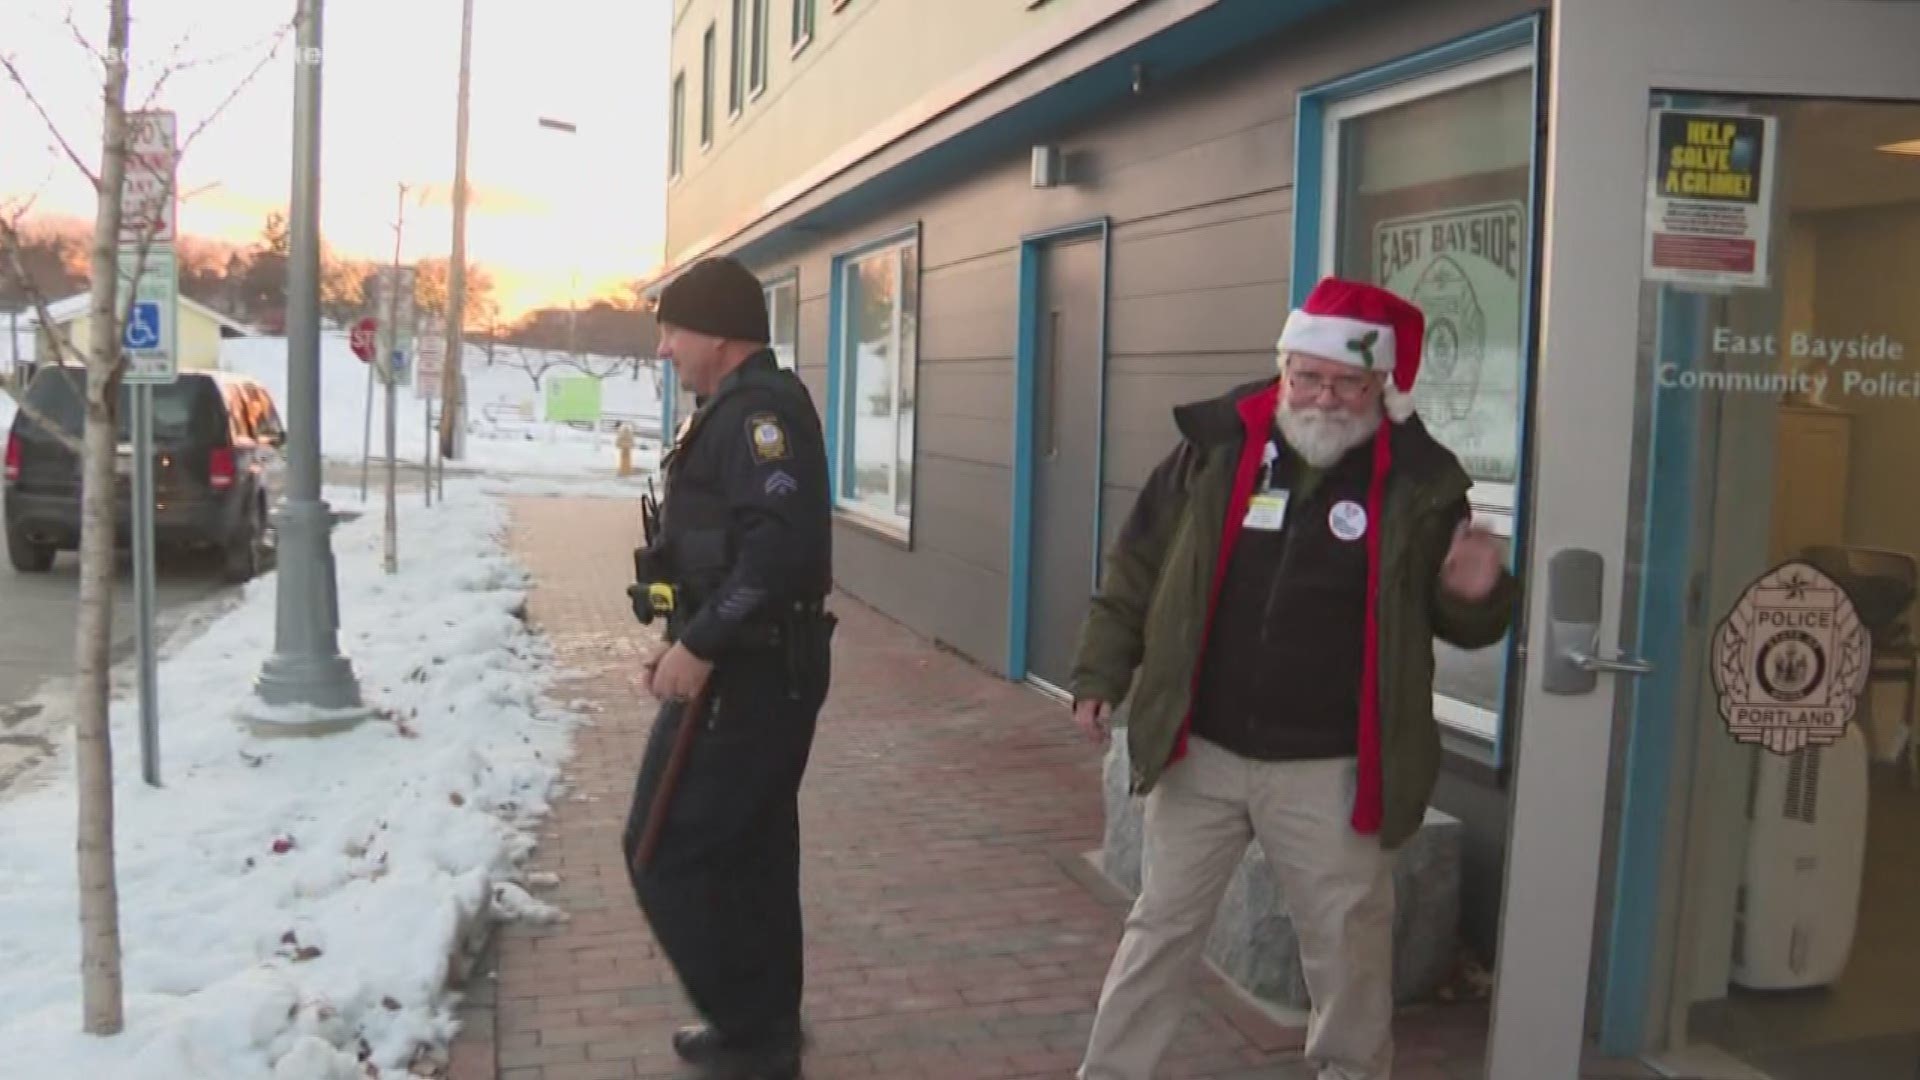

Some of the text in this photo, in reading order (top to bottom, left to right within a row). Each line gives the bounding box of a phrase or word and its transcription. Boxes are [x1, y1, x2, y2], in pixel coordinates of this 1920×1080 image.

[1687, 120, 1737, 146] HELP
[1669, 145, 1731, 171] SOLVE
[1665, 169, 1752, 198] A CRIME!
[1379, 215, 1518, 288] EAST BAYSIDE
[1712, 327, 1905, 365] East Bayside
[1658, 361, 1828, 400] Community
[1758, 610, 1833, 628] POLICE
[1737, 708, 1836, 726] PORTLAND
